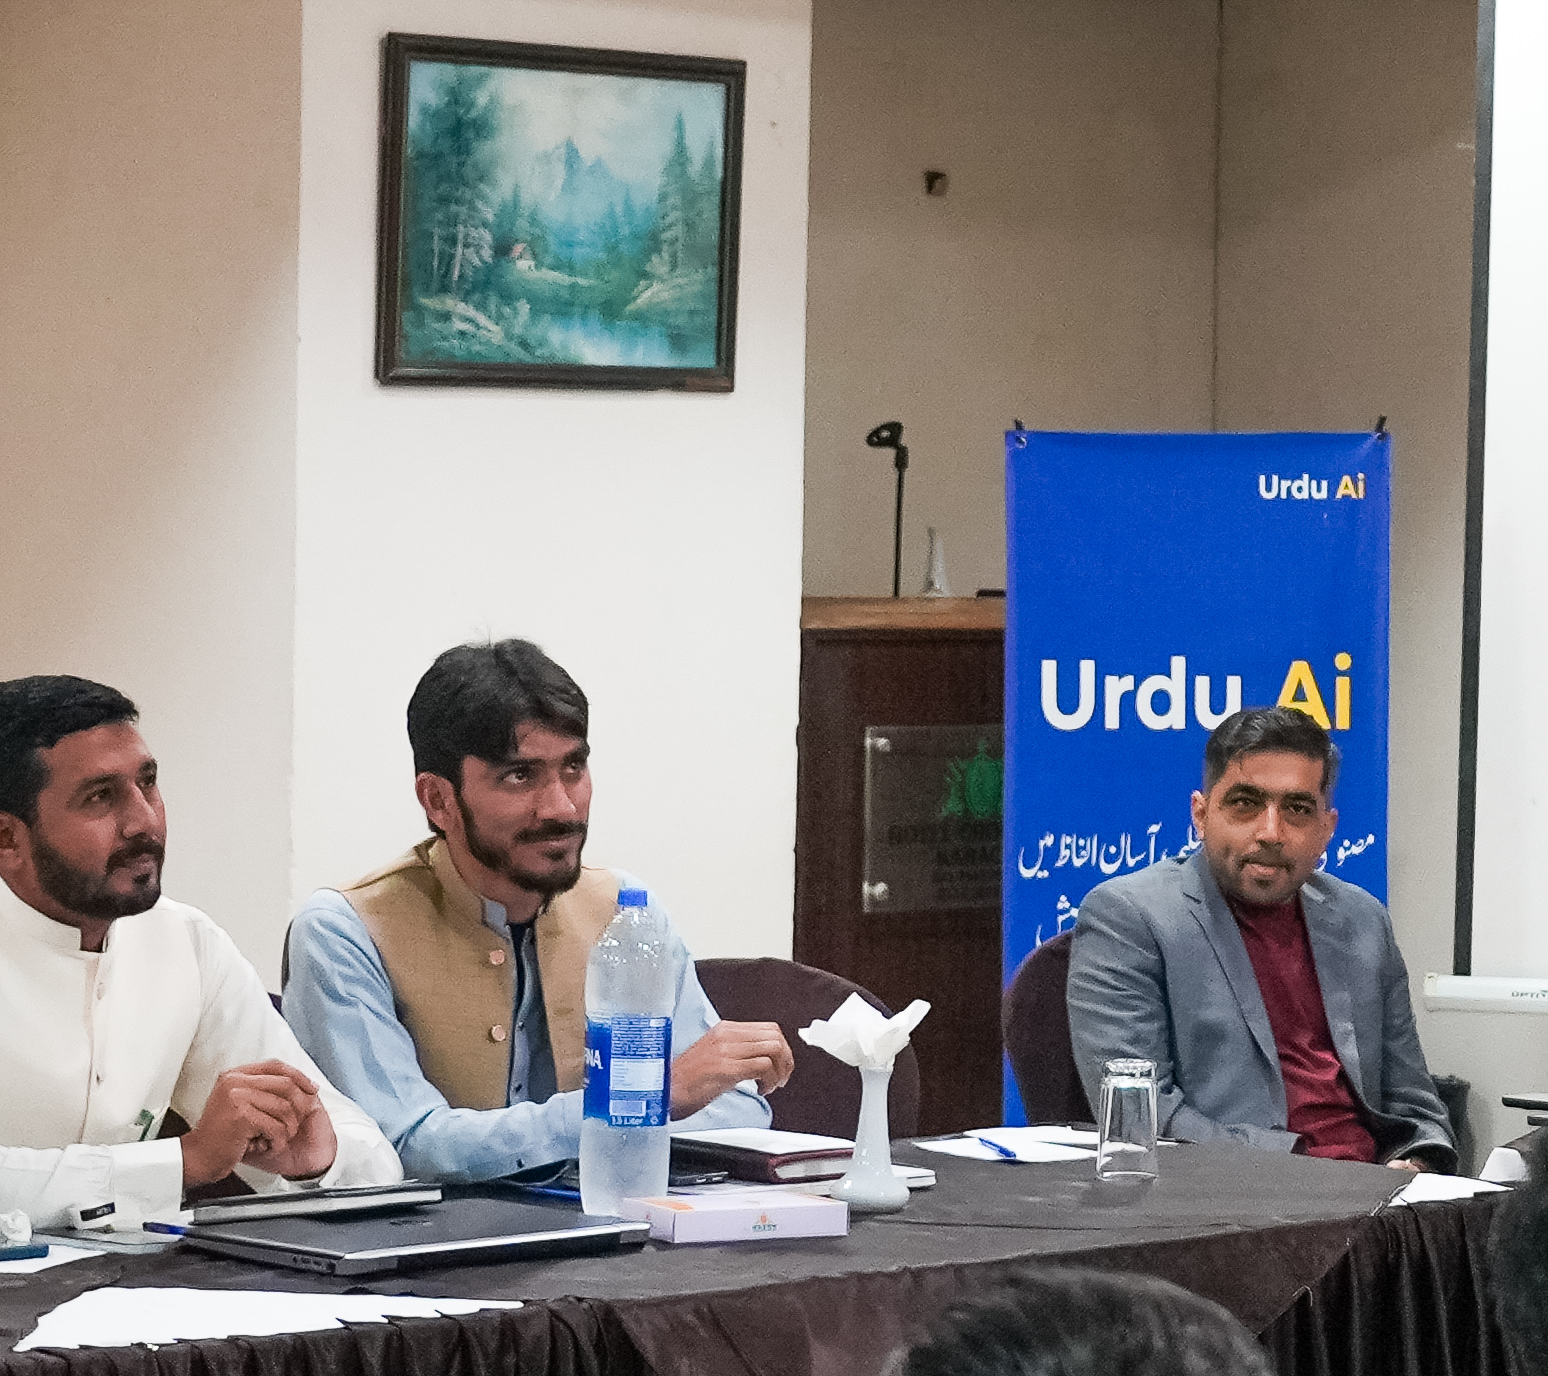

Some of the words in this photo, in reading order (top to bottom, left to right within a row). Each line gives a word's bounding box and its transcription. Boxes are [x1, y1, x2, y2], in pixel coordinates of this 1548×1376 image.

[1258, 473, 1329, 501] Urdu
[1336, 473, 1367, 501] Ai
[1041, 655, 1243, 732] Urdu
[1275, 652, 1353, 731] Ai
[1017, 830, 1055, 881] میں
[1053, 831, 1099, 868] الفاظ
[1098, 820, 1164, 875] آسان
